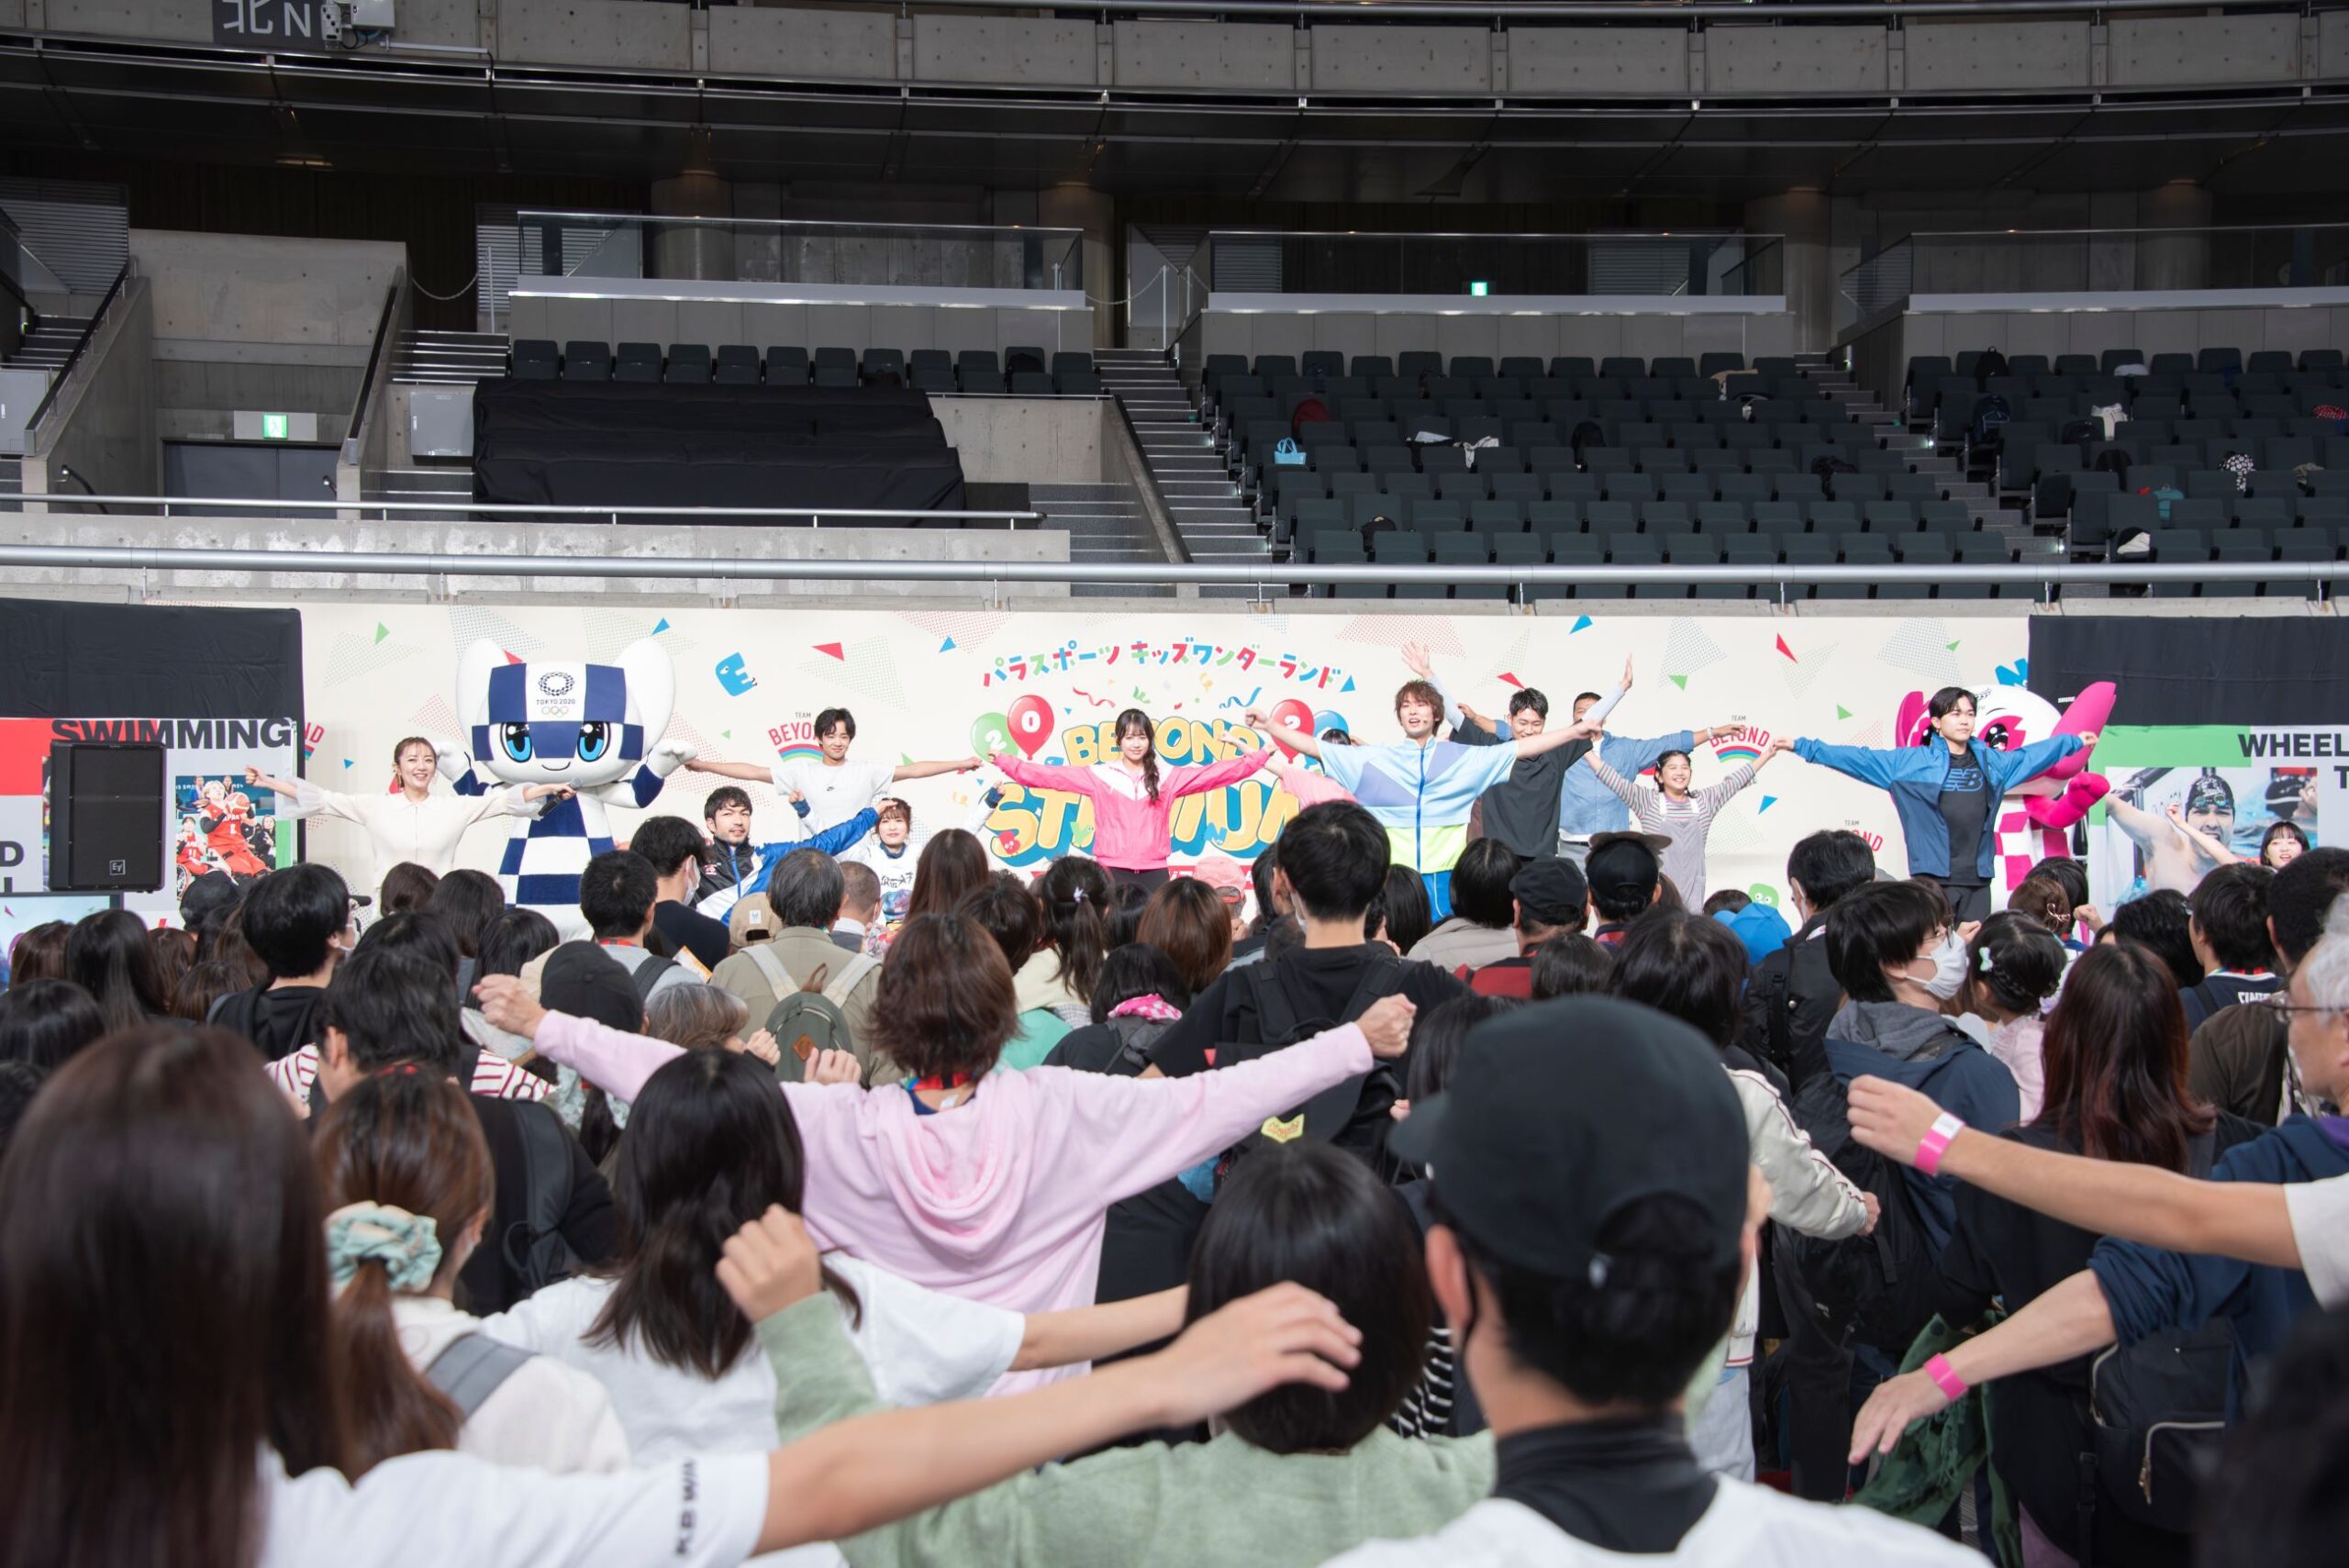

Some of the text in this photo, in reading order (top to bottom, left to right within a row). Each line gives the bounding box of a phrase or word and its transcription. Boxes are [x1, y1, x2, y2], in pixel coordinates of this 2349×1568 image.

[984, 637, 1341, 689] パラスポーツ キッズワンダーランド
[51, 717, 292, 751] SWIMMING
[768, 722, 823, 746] BEYO
[1062, 716, 1262, 767] BEOND
